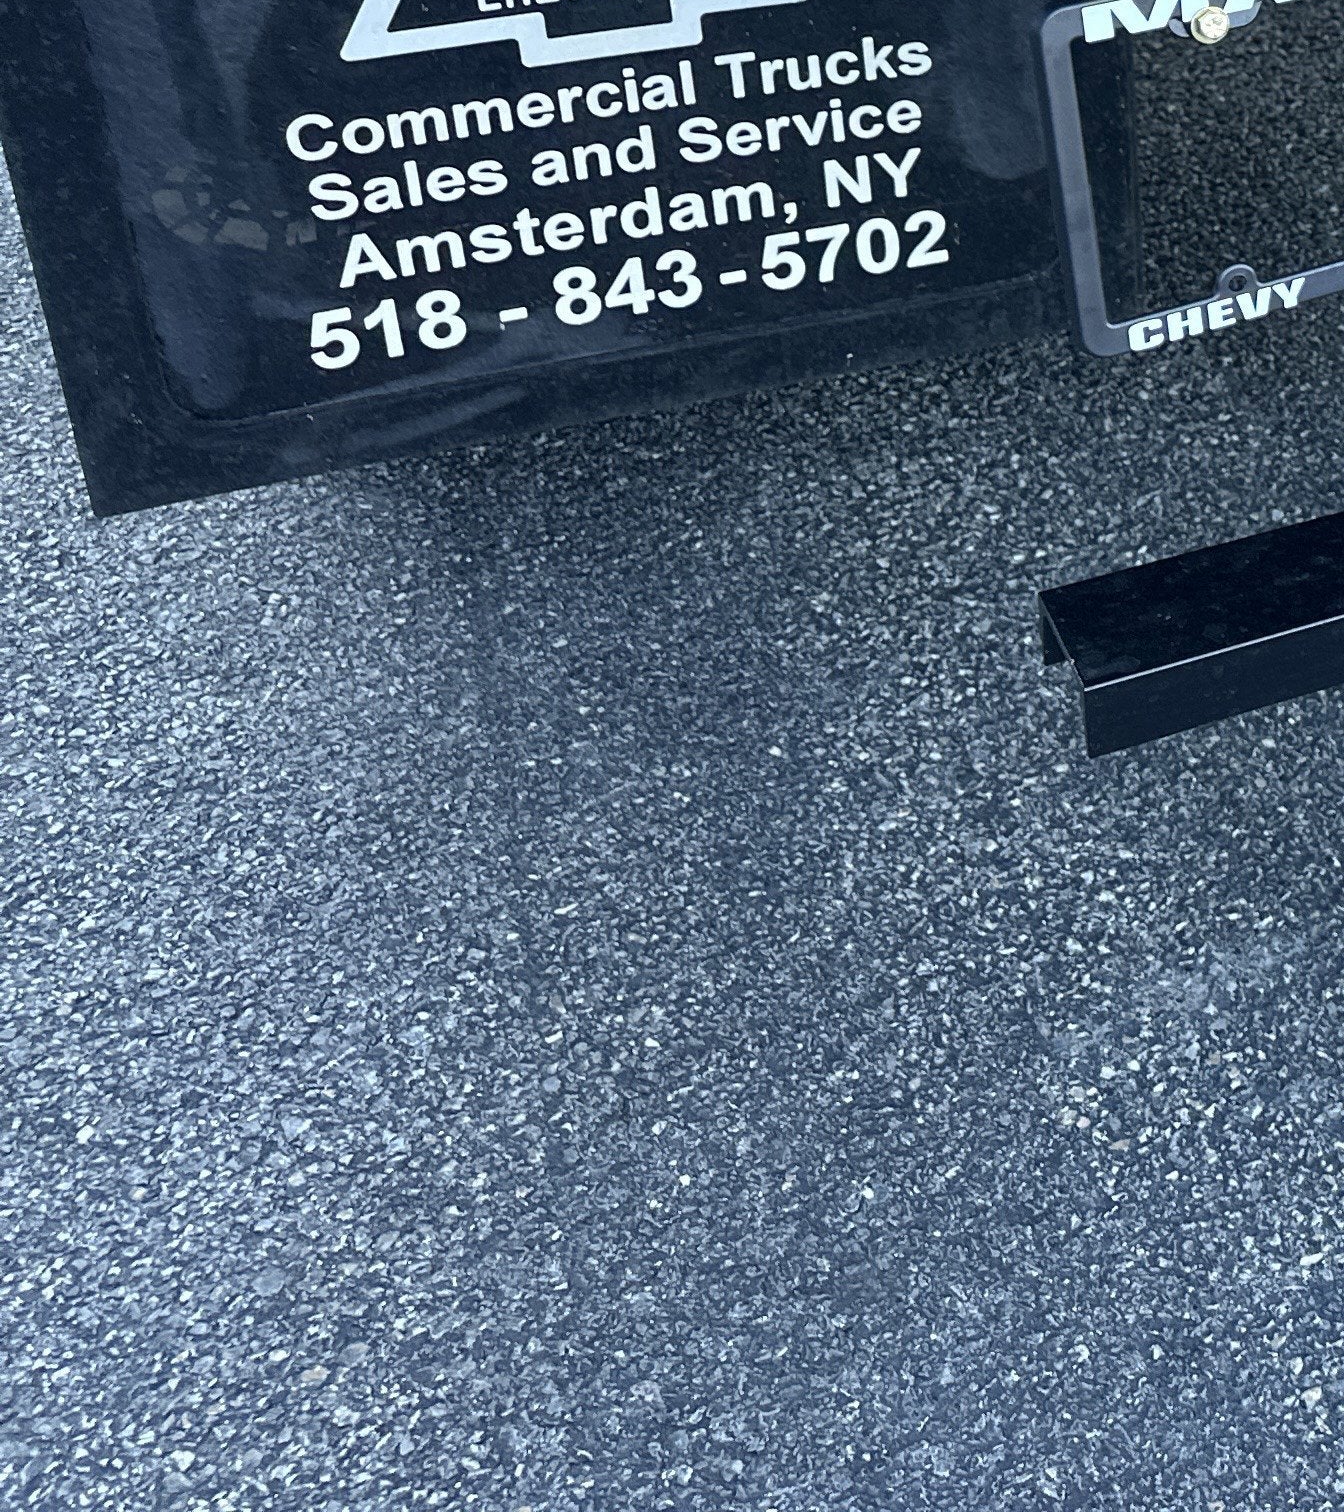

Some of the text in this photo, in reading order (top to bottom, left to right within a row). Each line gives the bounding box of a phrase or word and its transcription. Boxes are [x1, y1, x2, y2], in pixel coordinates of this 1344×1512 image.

[285, 36, 933, 162] Commercial Trucks
[308, 98, 922, 221] Sales and Service
[339, 147, 922, 289] Amsterdam, NY
[310, 289, 467, 370] 518
[1128, 276, 1306, 352] CHEVY
